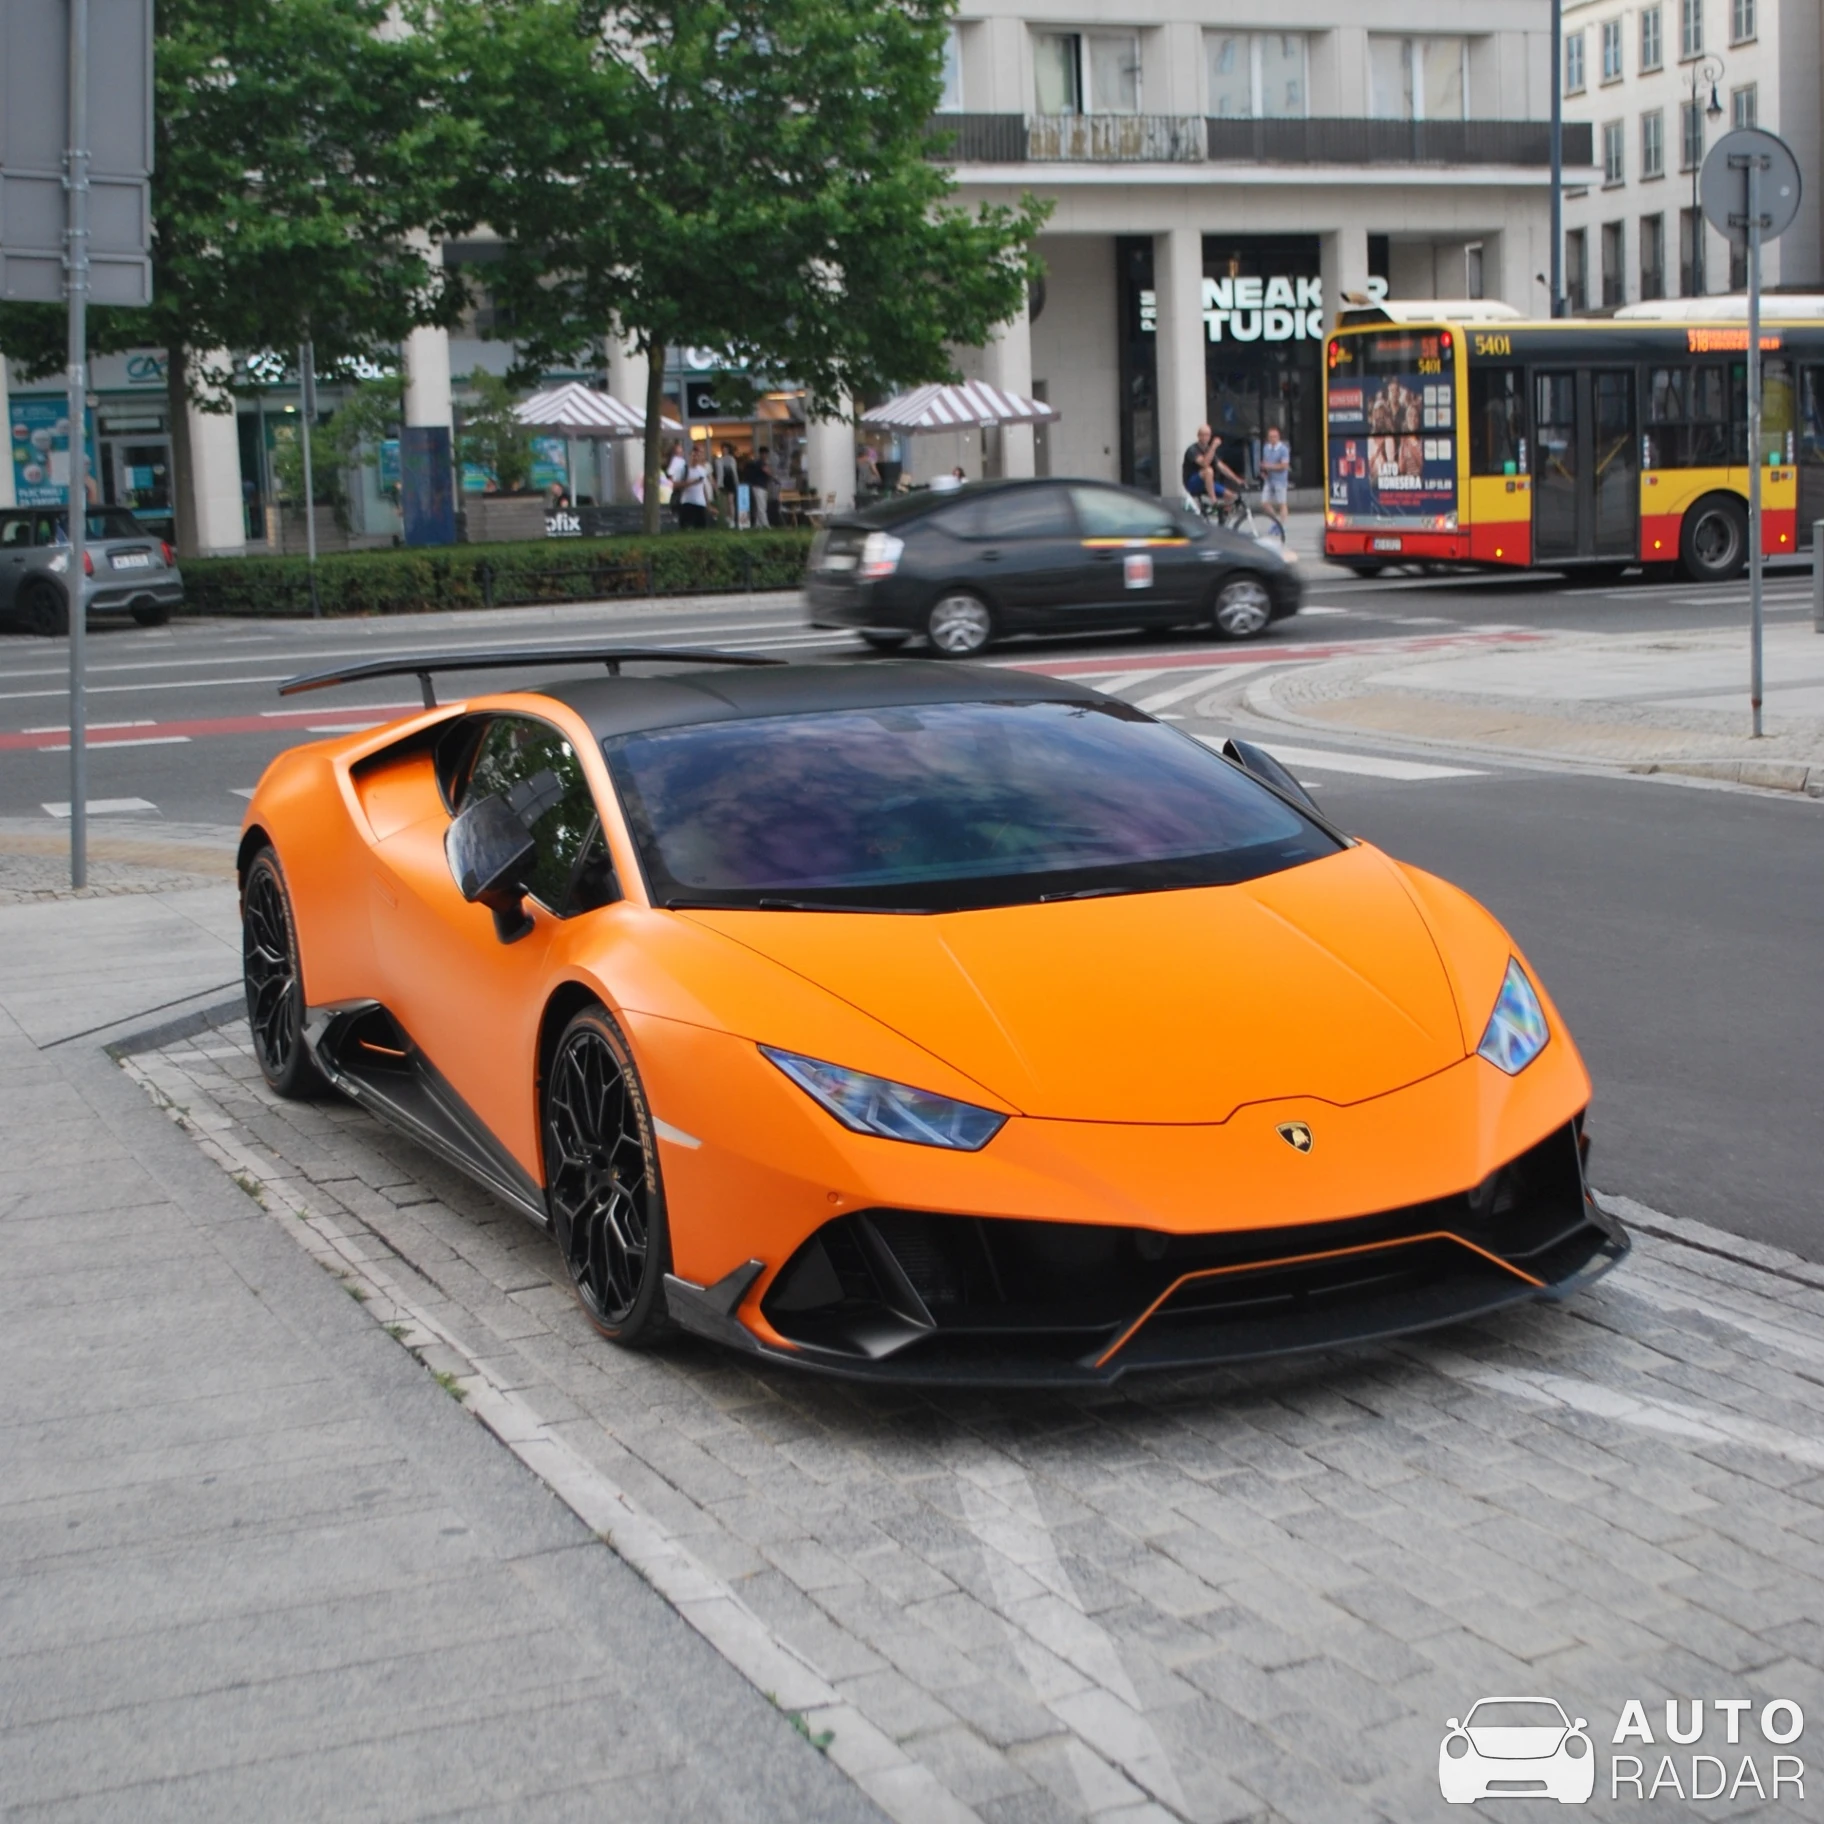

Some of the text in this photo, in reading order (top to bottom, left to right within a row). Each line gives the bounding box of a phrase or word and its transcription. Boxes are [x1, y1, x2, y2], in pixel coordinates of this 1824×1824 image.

[1475, 334, 1511, 355] 5401
[1418, 358, 1441, 374] 5401
[546, 512, 581, 532] ofix
[623, 1066, 657, 1195] MICHELIN
